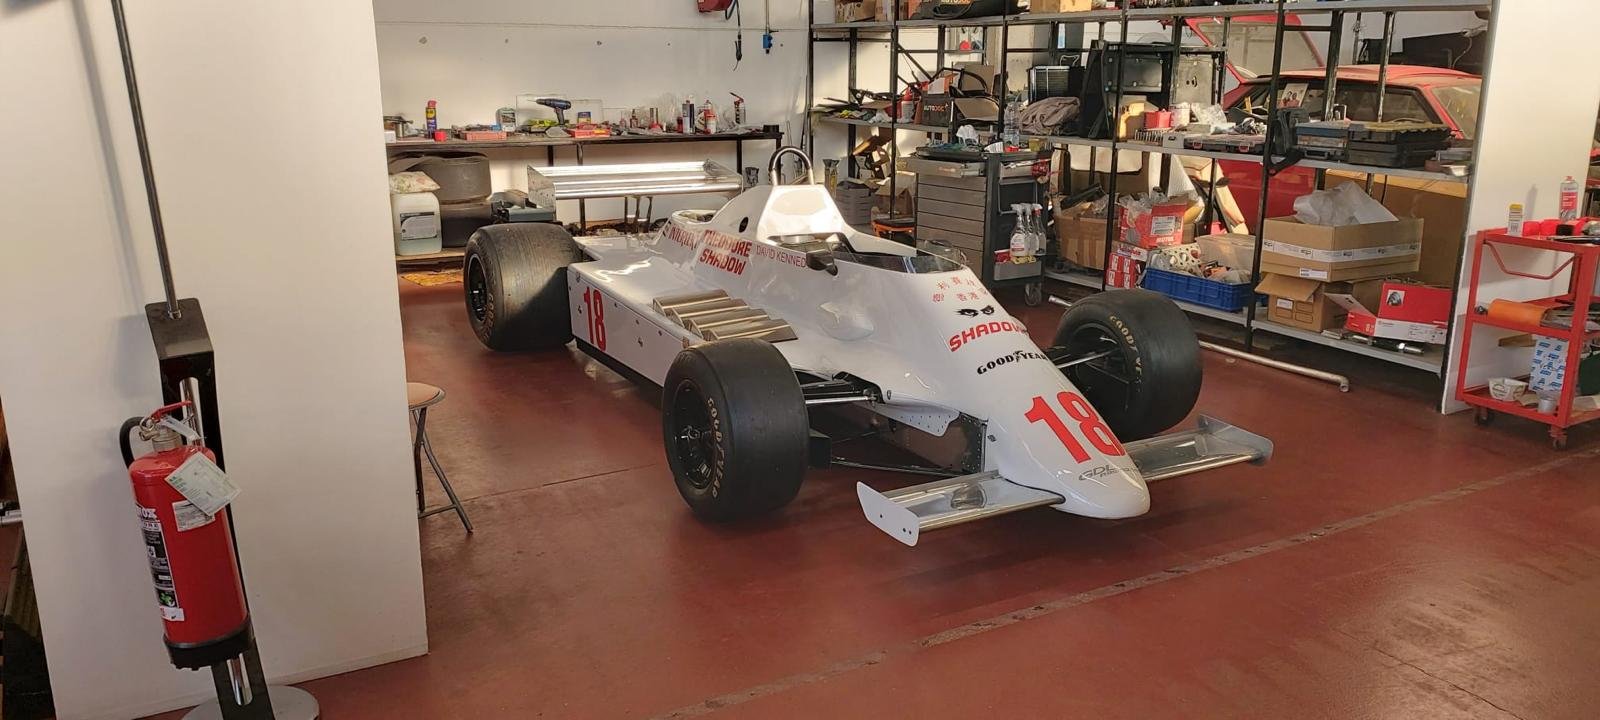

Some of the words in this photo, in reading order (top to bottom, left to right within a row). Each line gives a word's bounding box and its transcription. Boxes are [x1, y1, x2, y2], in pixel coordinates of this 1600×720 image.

[700, 248, 747, 276] SHADOW
[756, 244, 776, 260] DAVID
[776, 251, 807, 268] KENNED
[583, 286, 606, 352] 18
[1024, 391, 1126, 464] 18
